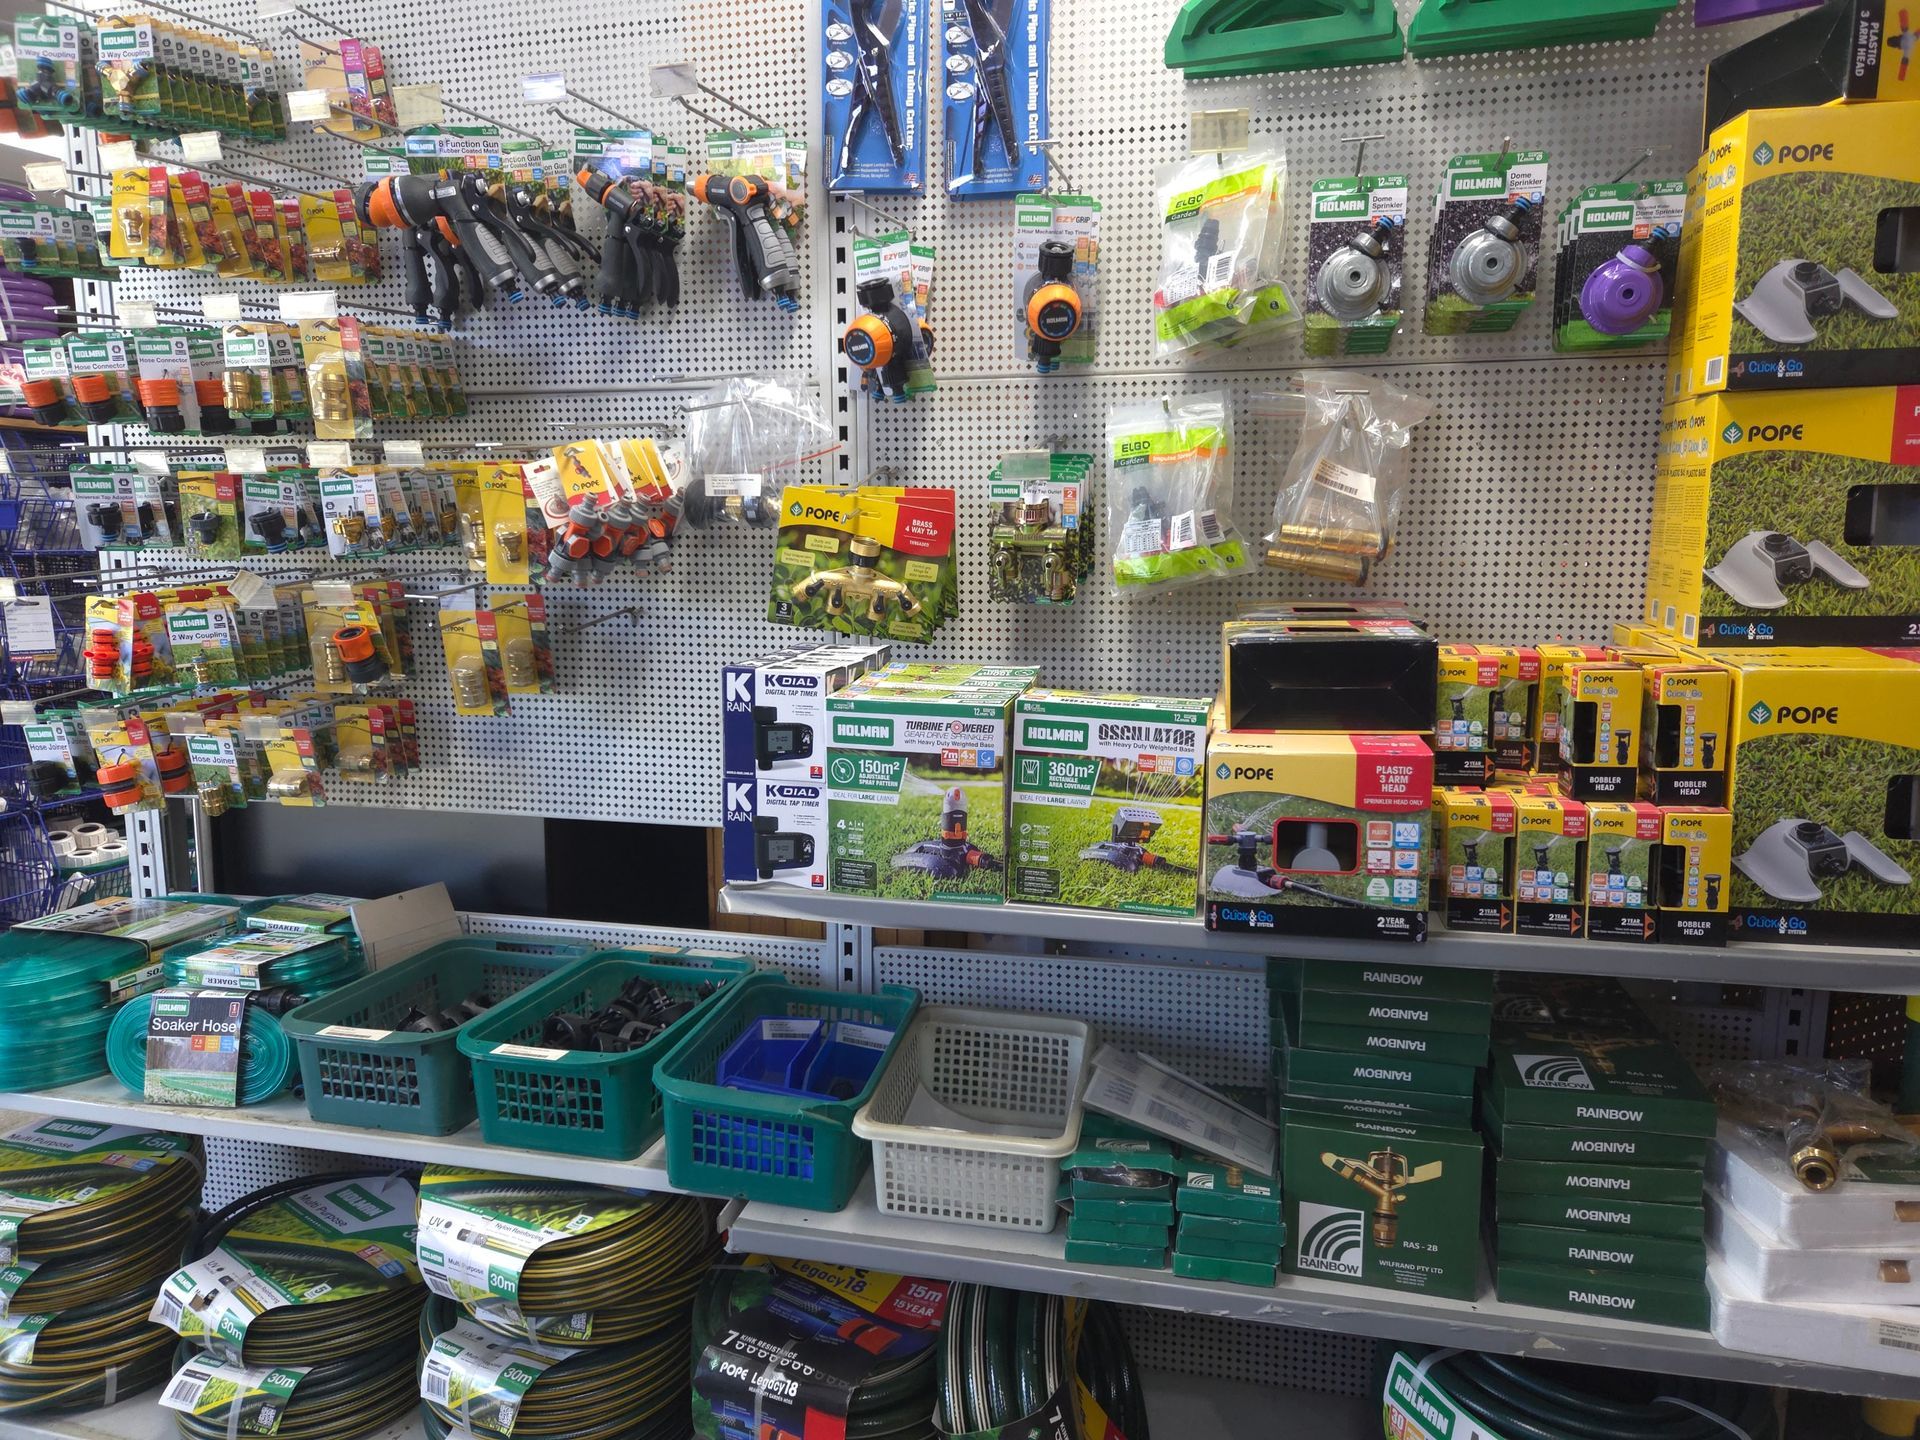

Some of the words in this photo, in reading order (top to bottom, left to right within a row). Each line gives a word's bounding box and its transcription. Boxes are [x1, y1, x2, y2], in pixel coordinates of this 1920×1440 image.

[908, 16, 916, 42] Pipe
[1028, 15, 1038, 42] Pipe
[1858, 22, 1868, 44] ARM
[1866, 22, 1880, 66] PLASTIC
[42, 50, 76, 59] Coupling
[122, 50, 150, 58] Coupling
[1028, 46, 1038, 68] and
[1855, 46, 1867, 77] HEAD
[906, 68, 916, 106] Tubing
[1028, 70, 1038, 110] Tubing
[906, 110, 915, 150] Cutter
[445, 140, 481, 148] Function
[1779, 143, 1834, 164] POPE
[1455, 177, 1502, 190] HOLMAN
[1320, 200, 1364, 212] HOLMAN
[1020, 215, 1049, 223] HOLMAN
[1171, 211, 1197, 220] Garden
[1587, 211, 1630, 222] HOLMAN
[1748, 424, 1803, 442] POPE
[1120, 457, 1145, 466] Garden
[581, 480, 600, 490] POPE
[806, 506, 840, 522] POPE
[911, 526, 925, 534] WAY
[912, 519, 933, 528] BRASS
[173, 619, 206, 627] HOLMAN
[726, 672, 752, 702] K
[765, 674, 776, 687] K
[782, 678, 814, 686] DIAL
[727, 702, 751, 712] RAIN
[1777, 706, 1839, 724] POPE
[837, 724, 889, 738] HOLMAN
[906, 721, 943, 732] TURBINE
[950, 733, 994, 741] SPRINKLER
[1028, 726, 1083, 742] HOLMAN
[1098, 724, 1196, 747] OSCILLATOR
[1112, 741, 1132, 750] Heavy
[1149, 744, 1178, 752] Weighted
[943, 751, 958, 759] 7m
[1048, 761, 1094, 778] 360m²
[1234, 767, 1273, 781] POPE
[1376, 766, 1413, 775] PLASTIC
[1379, 775, 1386, 783] 3
[1388, 775, 1409, 783] ARM
[766, 785, 777, 797] K
[784, 788, 815, 796] DIAL
[1064, 782, 1091, 791] COVERAGE
[1382, 784, 1406, 792] HEAD
[728, 782, 752, 811] K
[1047, 795, 1066, 804] LARGE
[1067, 797, 1086, 805] LAWNS
[728, 812, 752, 822] RAIN
[837, 819, 846, 829] 4
[1377, 917, 1385, 927] 2
[1363, 971, 1423, 986] RAINBOW
[1369, 1007, 1429, 1021] RAINBOW
[152, 1018, 199, 1030] Soaker
[202, 1019, 237, 1032] Hose
[1367, 1036, 1426, 1051] RAINBOW
[1353, 1066, 1412, 1082] RAINBOW
[1527, 1080, 1589, 1089] RAINBOW
[1577, 1107, 1643, 1121] RAINBOW
[44, 1122, 100, 1136] HOLMAN
[1355, 1121, 1417, 1135] RAINBOW
[9, 1133, 33, 1142] Multi
[34, 1139, 73, 1149] Purpose
[138, 1136, 177, 1150] 15m
[1571, 1141, 1635, 1154] RAINBOW
[1566, 1176, 1631, 1190] RAINBOW
[336, 1189, 384, 1217] HOLMAN
[301, 1194, 319, 1209] Multi
[319, 1205, 348, 1227] Purpose
[1566, 1208, 1631, 1224] RAINBOW
[429, 1215, 444, 1227] UV
[1403, 1241, 1420, 1250] RAS
[1569, 1247, 1634, 1264] RAINBOW
[1300, 1257, 1359, 1274] RAINBOW
[1379, 1260, 1415, 1270] WILFRAND
[1, 1269, 22, 1284] 15m
[490, 1274, 516, 1293] 30m
[907, 1284, 943, 1303] 15m
[1569, 1290, 1635, 1310] RAINBOW
[25, 1314, 48, 1326] 15m
[221, 1318, 242, 1341] 30m
[721, 1330, 739, 1345] 7
[740, 1334, 757, 1344] KINK
[757, 1340, 798, 1359] RESISTANCE
[504, 1368, 532, 1385] 30m
[720, 1362, 748, 1380] POPE
[267, 1373, 296, 1388] 30m
[1394, 1374, 1449, 1435] HOLMAN
